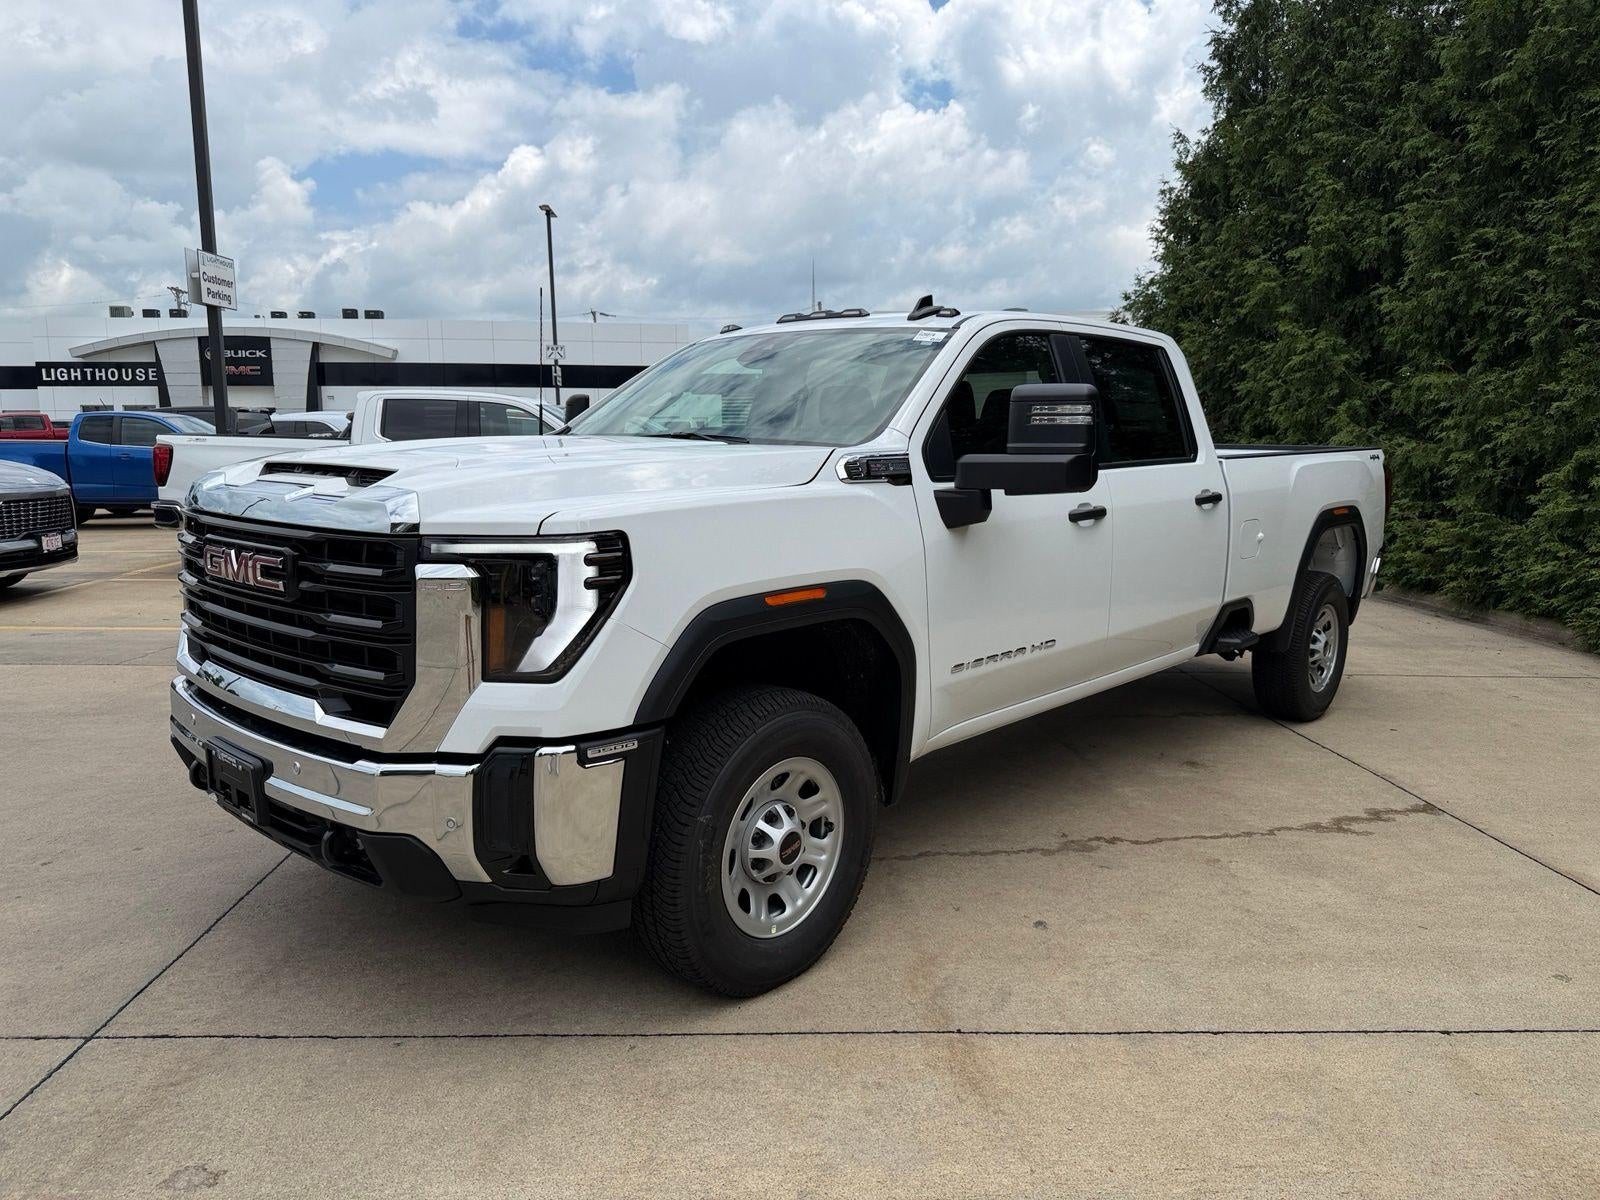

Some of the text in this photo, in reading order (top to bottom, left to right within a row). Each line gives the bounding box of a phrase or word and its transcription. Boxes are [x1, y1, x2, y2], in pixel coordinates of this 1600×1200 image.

[202, 271, 234, 288] Customer
[207, 287, 232, 305] Parking
[41, 367, 158, 381] LIGHTHOUSE
[203, 544, 285, 592] GMC
[950, 639, 1056, 674] SIERRA HD
[587, 739, 638, 759] 3500
